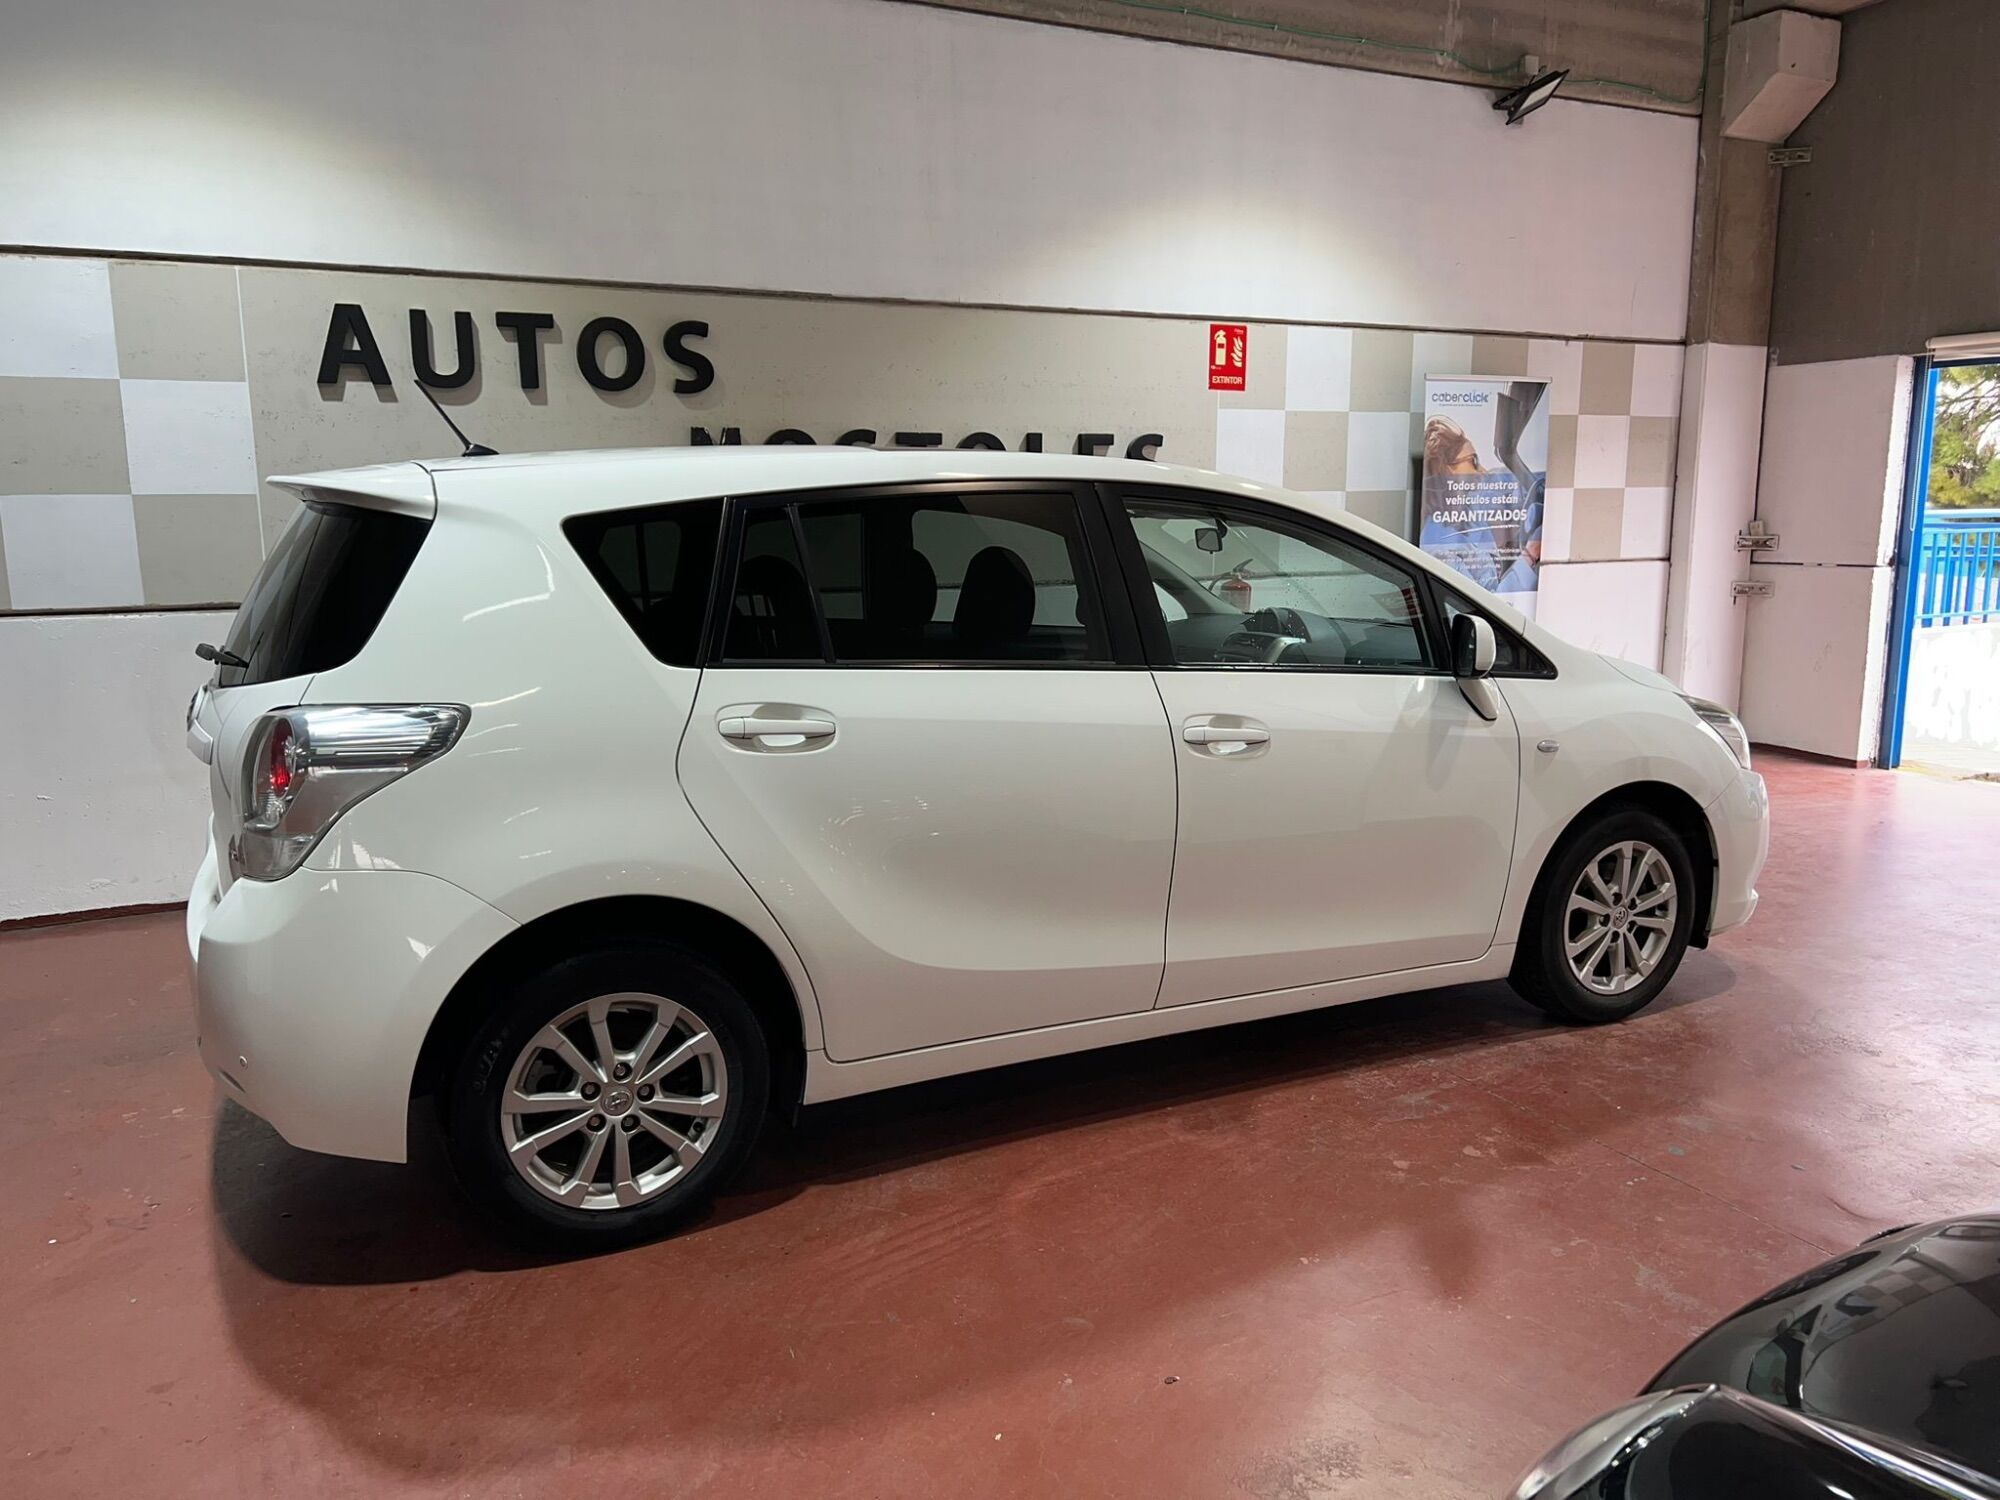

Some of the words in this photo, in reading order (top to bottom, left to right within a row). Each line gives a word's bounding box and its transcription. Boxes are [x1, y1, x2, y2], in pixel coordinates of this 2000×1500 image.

[317, 303, 715, 394] AUTOS
[1212, 376, 1243, 385] EXTINTOR
[1447, 480, 1476, 491] Todos
[1477, 481, 1519, 490] nuestros
[1491, 494, 1519, 504] están
[1432, 509, 1528, 523] GARANTIZADOS
